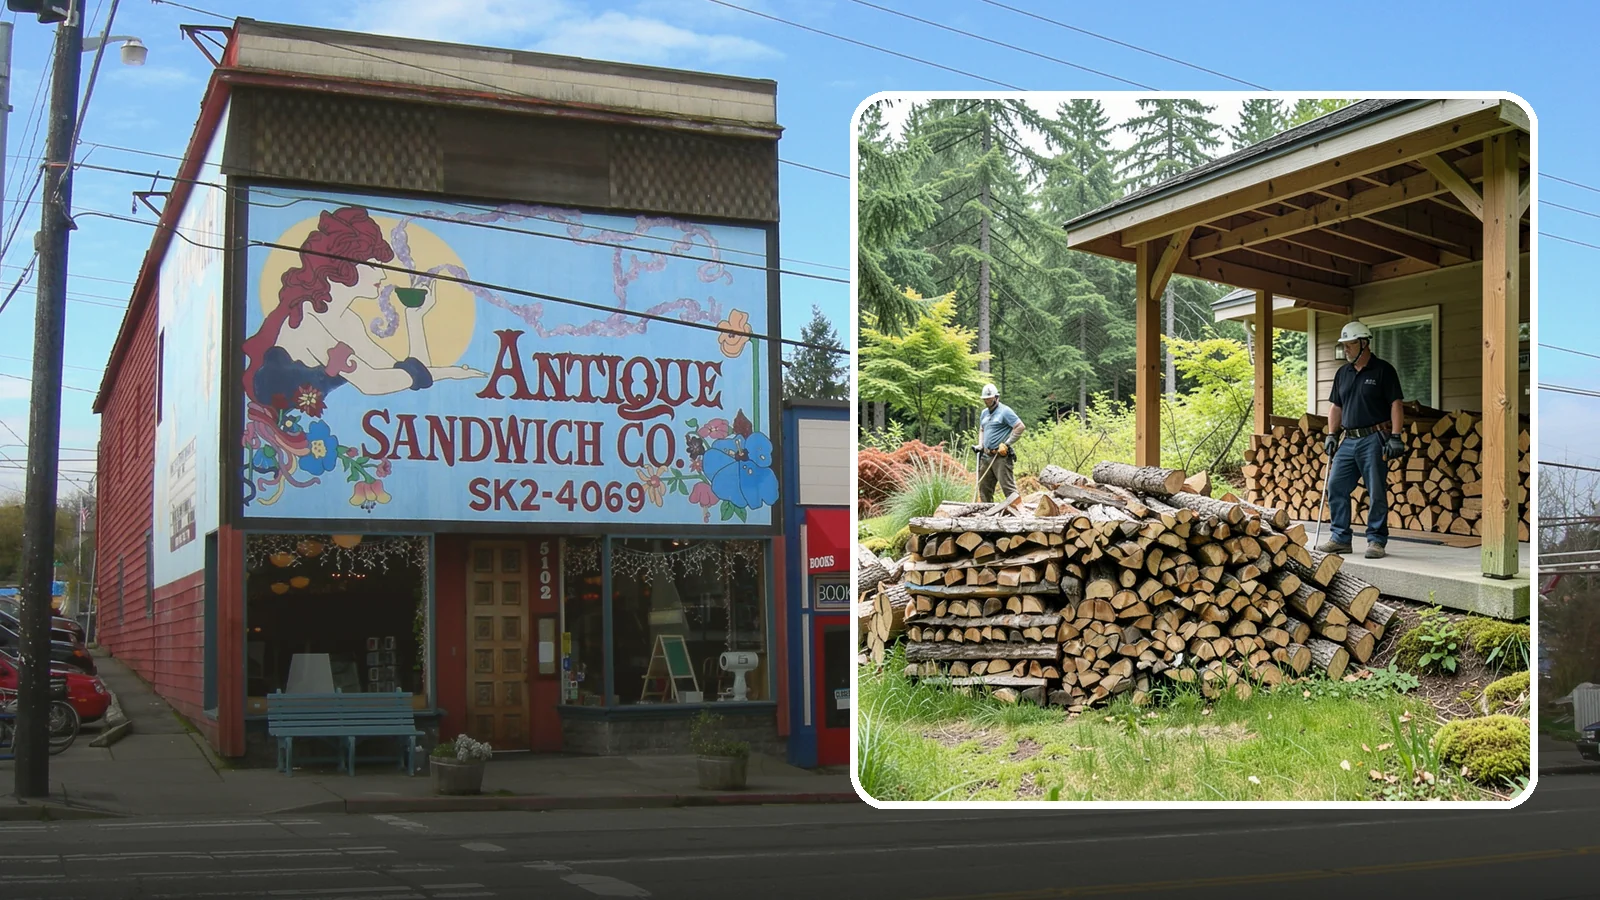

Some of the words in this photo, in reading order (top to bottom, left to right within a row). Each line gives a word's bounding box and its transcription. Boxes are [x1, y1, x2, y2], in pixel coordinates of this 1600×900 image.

[476, 330, 724, 420] ANTIQUE
[361, 409, 604, 467] SANDWICH
[618, 421, 685, 468] CO.
[468, 476, 645, 512] SK2-4069
[540, 542, 551, 599] 5102
[809, 555, 835, 569] BOOKS
